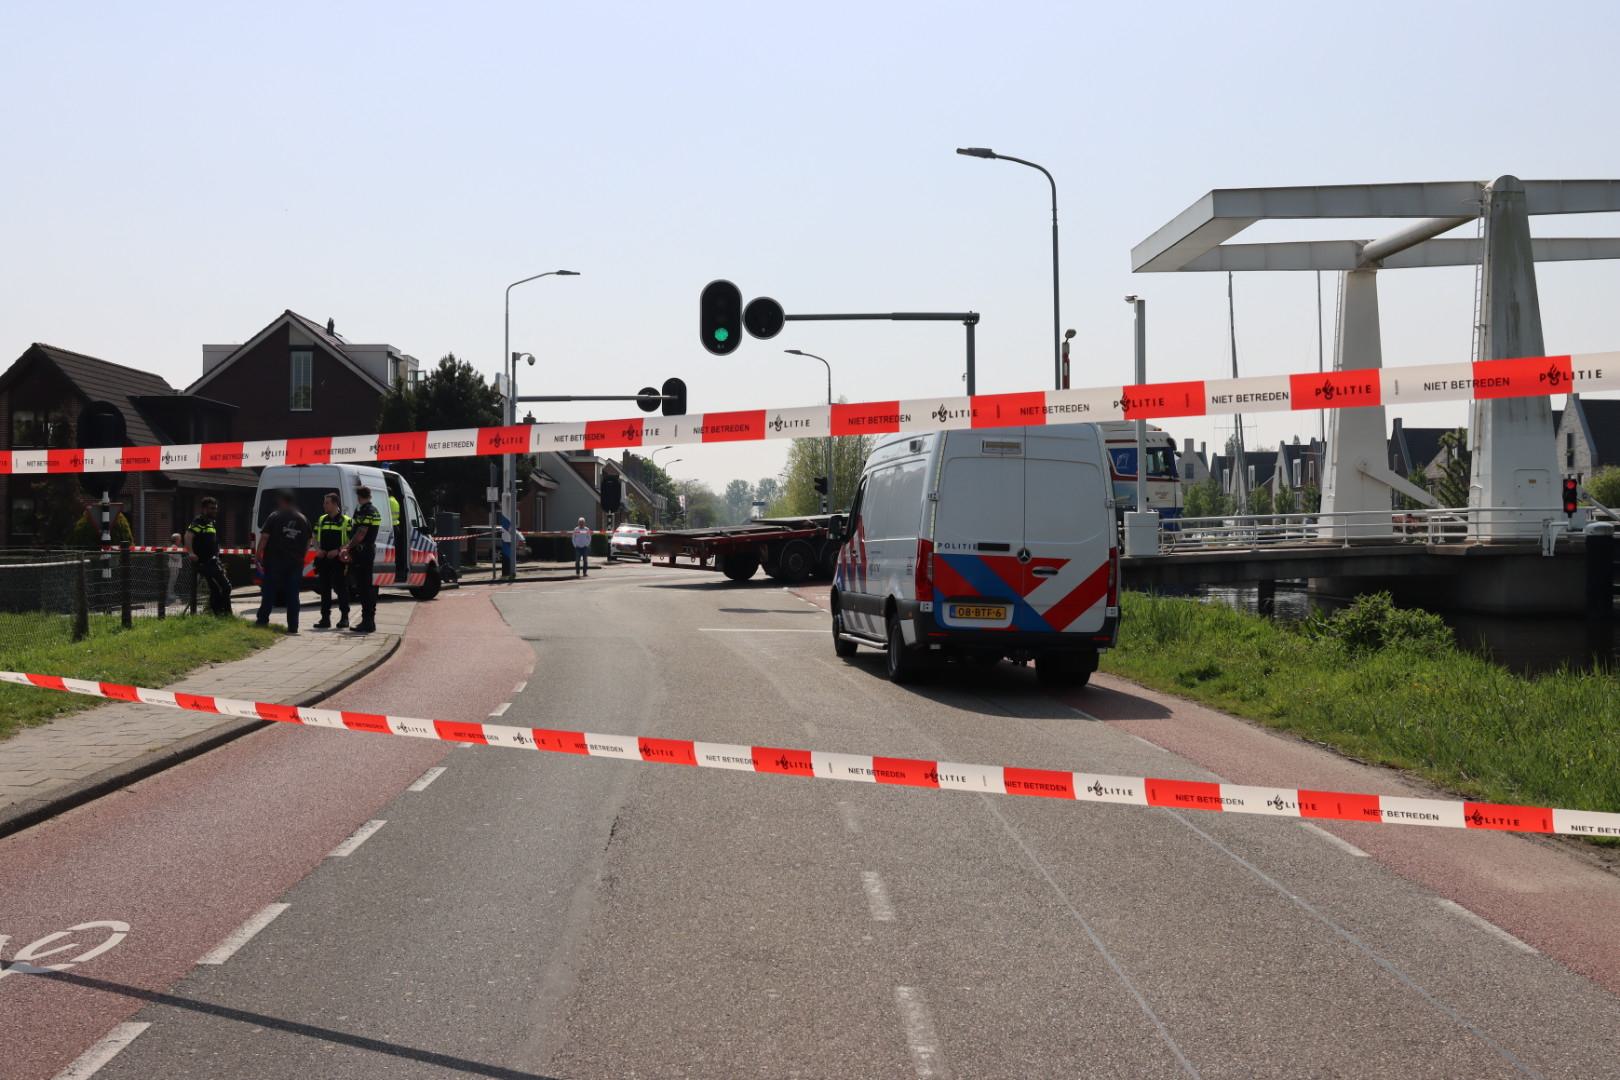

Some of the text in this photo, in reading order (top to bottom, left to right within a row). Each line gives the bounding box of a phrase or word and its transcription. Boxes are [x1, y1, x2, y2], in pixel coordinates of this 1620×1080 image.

[161, 451, 188, 465] POLITIE
[261, 445, 289, 461] POLITIE
[369, 440, 400, 455] POLITIE
[428, 442, 442, 450] NIET
[442, 440, 474, 449] BETREDEN
[489, 433, 524, 448] POLITIE
[554, 434, 569, 443] NIET
[570, 433, 605, 442] BETREDEN
[622, 423, 660, 441] POLITIE
[693, 425, 710, 434] NIET
[710, 424, 750, 434] BETREDEN
[768, 414, 811, 432] POLITIE
[848, 416, 866, 425] NIET
[868, 414, 911, 424] BETREDEN
[932, 403, 978, 422] POLITIE
[1020, 406, 1040, 416] NIET
[1042, 404, 1090, 415] BETREDEN
[1113, 392, 1165, 413] POLITIE
[1212, 394, 1233, 404] NIET
[1236, 392, 1289, 404] BETREDEN
[1314, 379, 1372, 400] POLITIE
[1424, 380, 1448, 391] NIET
[1450, 378, 1510, 390] BETREDEN
[1539, 363, 1602, 386] POLITIE
[512, 732, 546, 745] POLITIE
[590, 744, 624, 754] BETREDEN
[639, 743, 674, 758] POLITIE
[722, 756, 759, 766] BETREDEN
[775, 754, 814, 770] POLITIE
[848, 767, 864, 776] NIET
[866, 768, 906, 779] BETREDEN
[924, 767, 967, 783] POLITIE
[1004, 780, 1022, 788] NIET
[1024, 782, 1067, 792] BETREDEN
[1087, 780, 1134, 797] POLITIE
[1175, 794, 1194, 802] NIET
[1196, 794, 1244, 806] BETREDEN
[1266, 794, 1319, 812] POLITIE
[1363, 808, 1384, 817] NIET
[1386, 810, 1440, 822] BETREDEN
[1464, 809, 1520, 827] POLITIE
[1570, 824, 1594, 833] NIET
